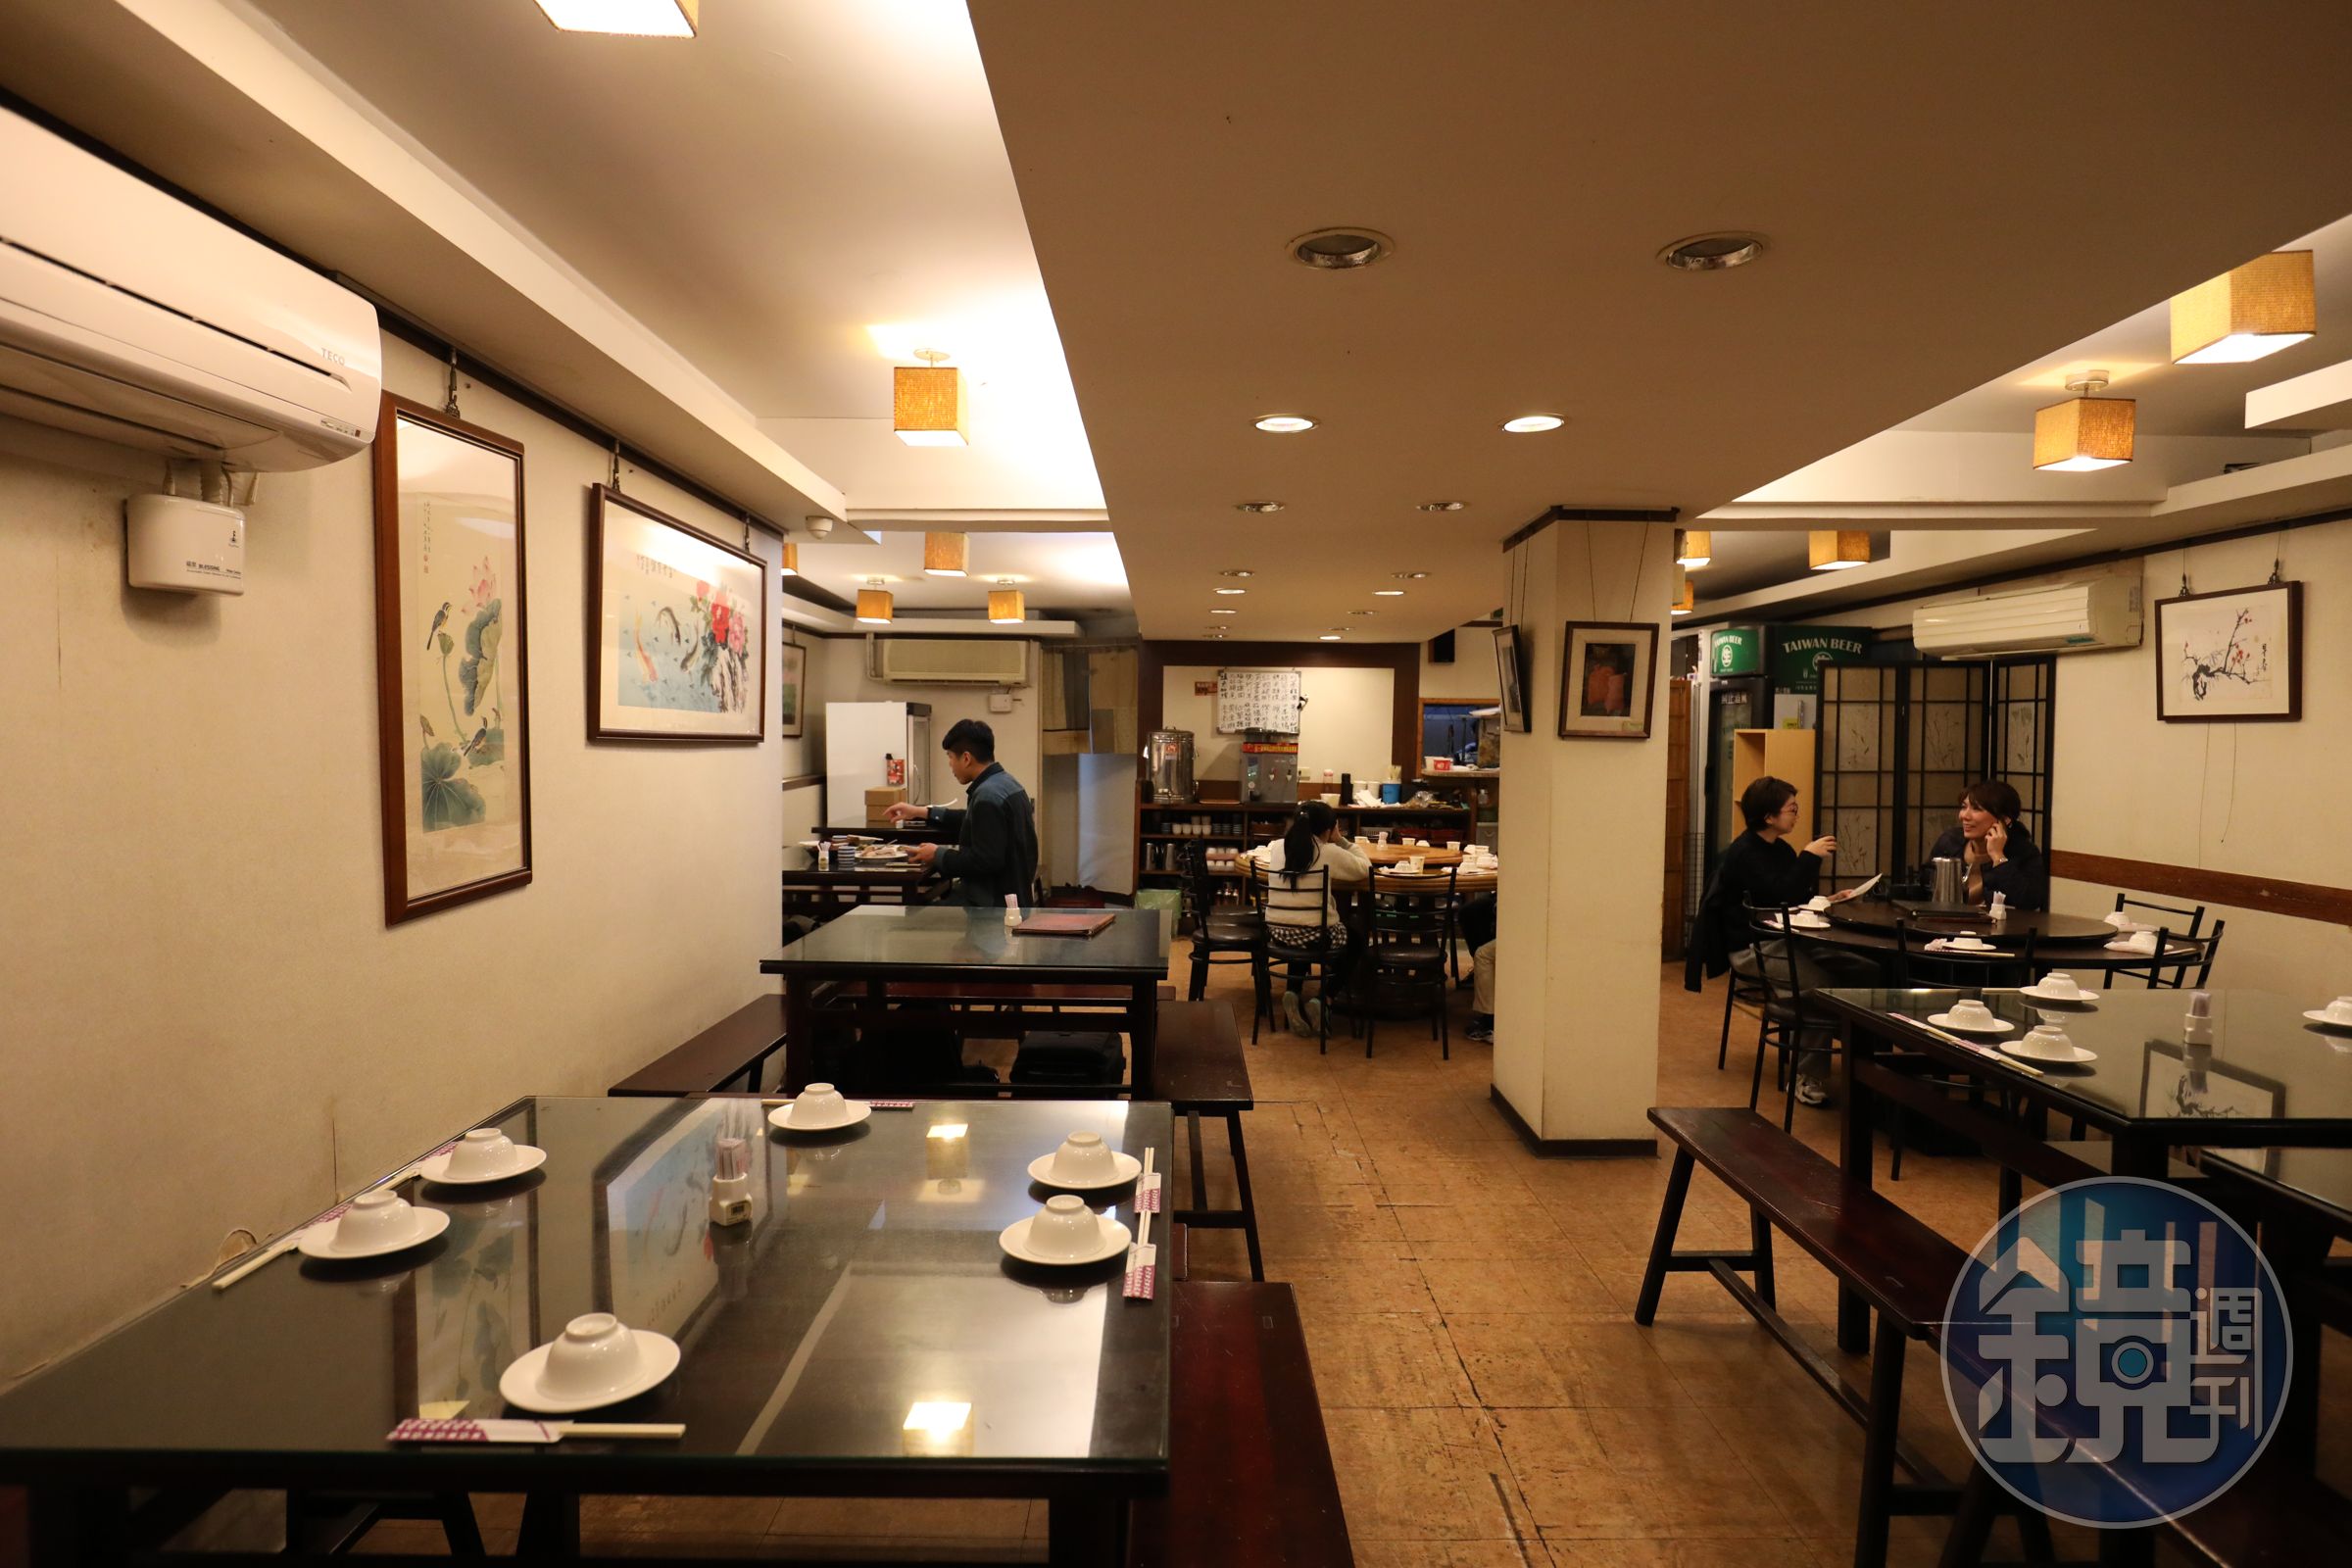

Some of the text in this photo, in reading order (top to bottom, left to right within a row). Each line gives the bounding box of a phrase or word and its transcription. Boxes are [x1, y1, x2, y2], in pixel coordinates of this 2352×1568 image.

[321, 348, 345, 366] TECO
[1729, 635, 1742, 645] BEER
[1783, 638, 1863, 655] TAIWAN BEER
